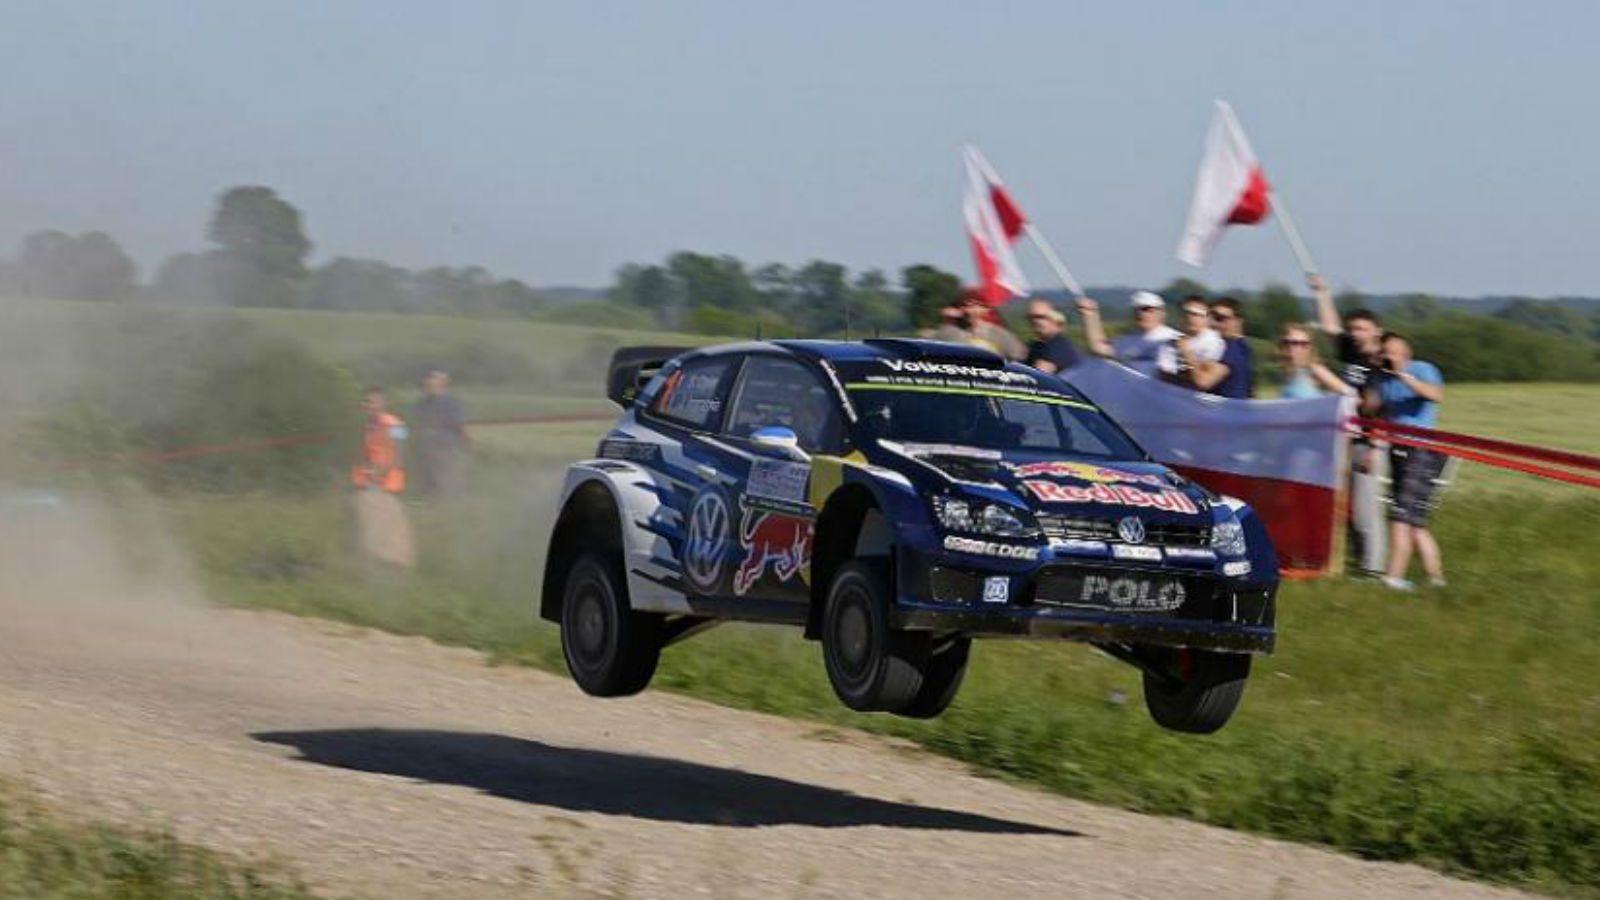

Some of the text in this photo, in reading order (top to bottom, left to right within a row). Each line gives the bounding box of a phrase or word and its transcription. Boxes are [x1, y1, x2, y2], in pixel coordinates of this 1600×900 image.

[877, 357, 1038, 385] Volkswagen
[1021, 479, 1199, 515] Red Bull
[986, 541, 1040, 561] EDGE
[1080, 574, 1187, 611] POLO
